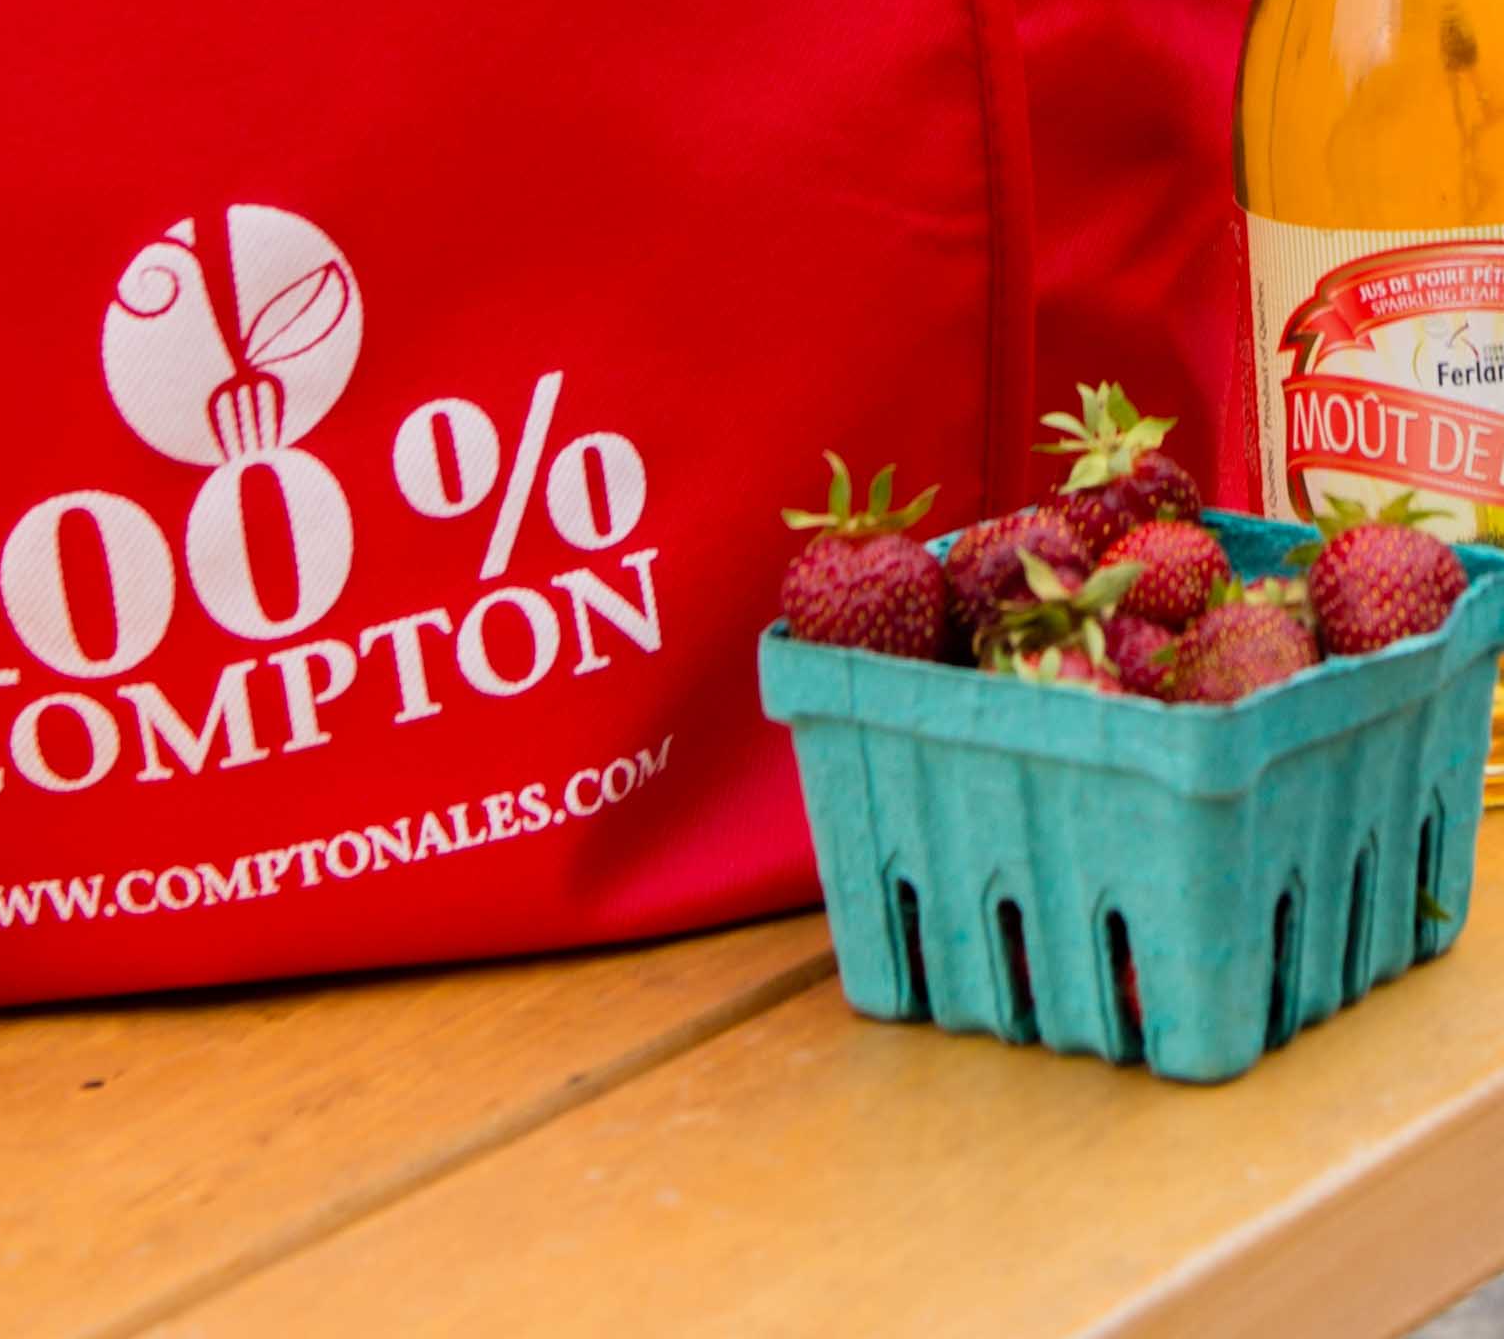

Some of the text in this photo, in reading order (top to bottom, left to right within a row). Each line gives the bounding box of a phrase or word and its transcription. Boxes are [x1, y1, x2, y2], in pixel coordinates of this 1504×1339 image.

[1359, 280, 1387, 303] JUS
[1389, 276, 1410, 295] DE
[1415, 268, 1467, 291] POIRE
[1371, 287, 1458, 317] SPARKLING
[1459, 285, 1500, 302] PEAR
[1292, 388, 1419, 466] MOÛT
[1427, 415, 1491, 482] DE
[392, 369, 648, 582] %
